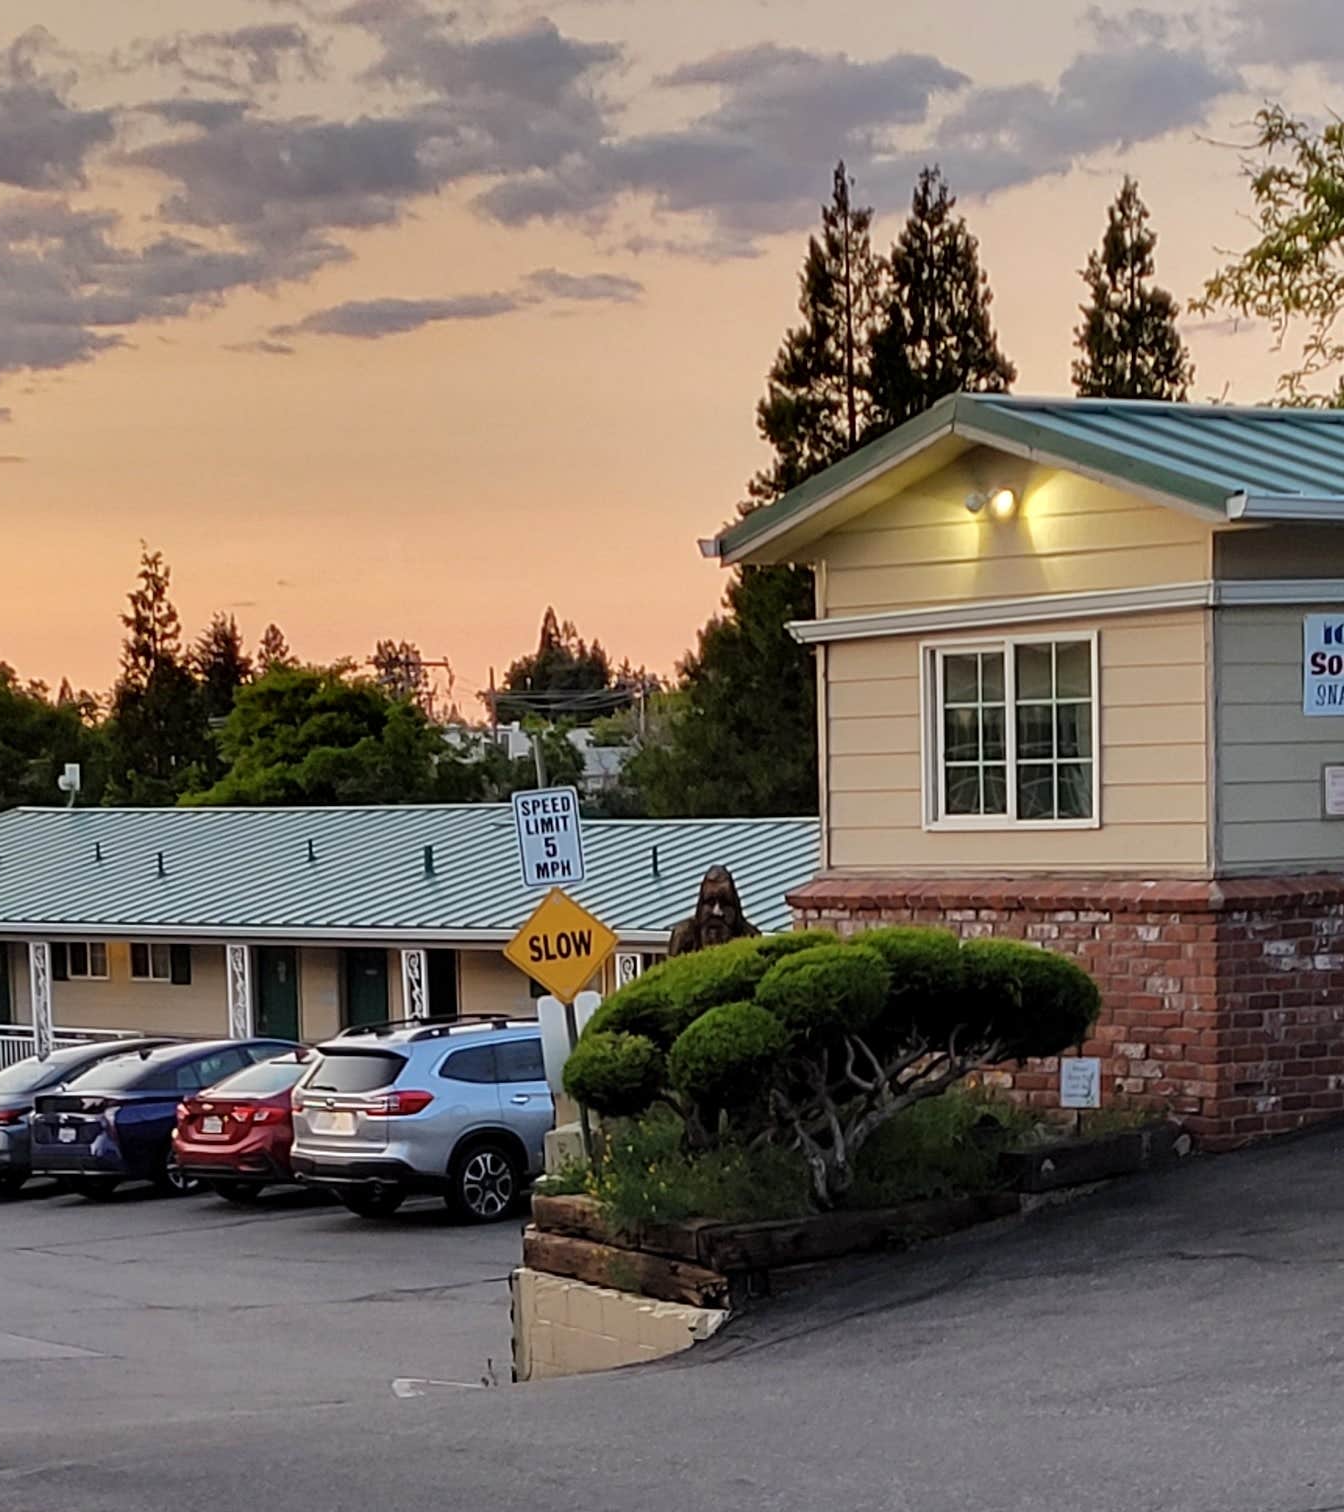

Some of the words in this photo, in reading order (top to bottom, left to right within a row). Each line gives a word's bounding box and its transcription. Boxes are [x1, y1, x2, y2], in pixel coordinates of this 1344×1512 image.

[521, 796, 570, 816] SPEED
[525, 816, 569, 835] LIMIT
[545, 837, 557, 857] 5
[536, 860, 572, 879] MPH
[529, 931, 592, 962] SLOW
